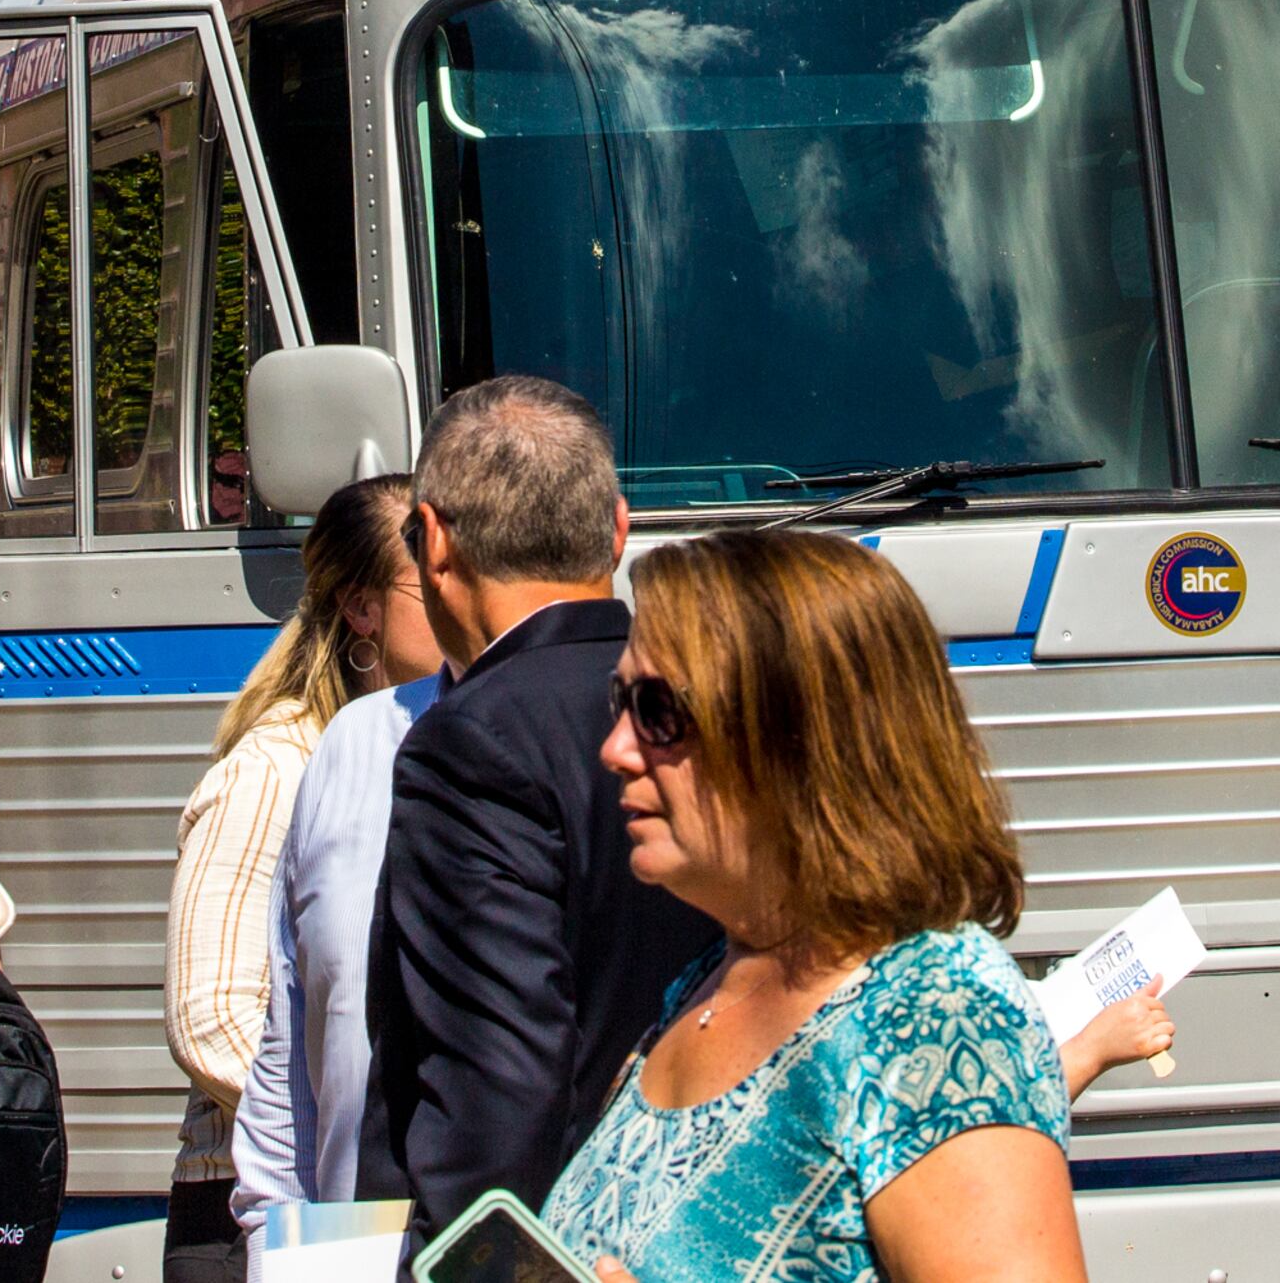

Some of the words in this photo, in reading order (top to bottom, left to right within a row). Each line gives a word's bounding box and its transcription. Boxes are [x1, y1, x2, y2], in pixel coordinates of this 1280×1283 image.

[10, 37, 66, 101] HISTORI
[1160, 538, 1224, 564] COMMISSION
[1151, 564, 1175, 621] HISTORICAL
[1181, 565, 1230, 593] ahc
[1174, 611, 1225, 631] ALABAMA
[1095, 958, 1144, 1002] FREEDOM
